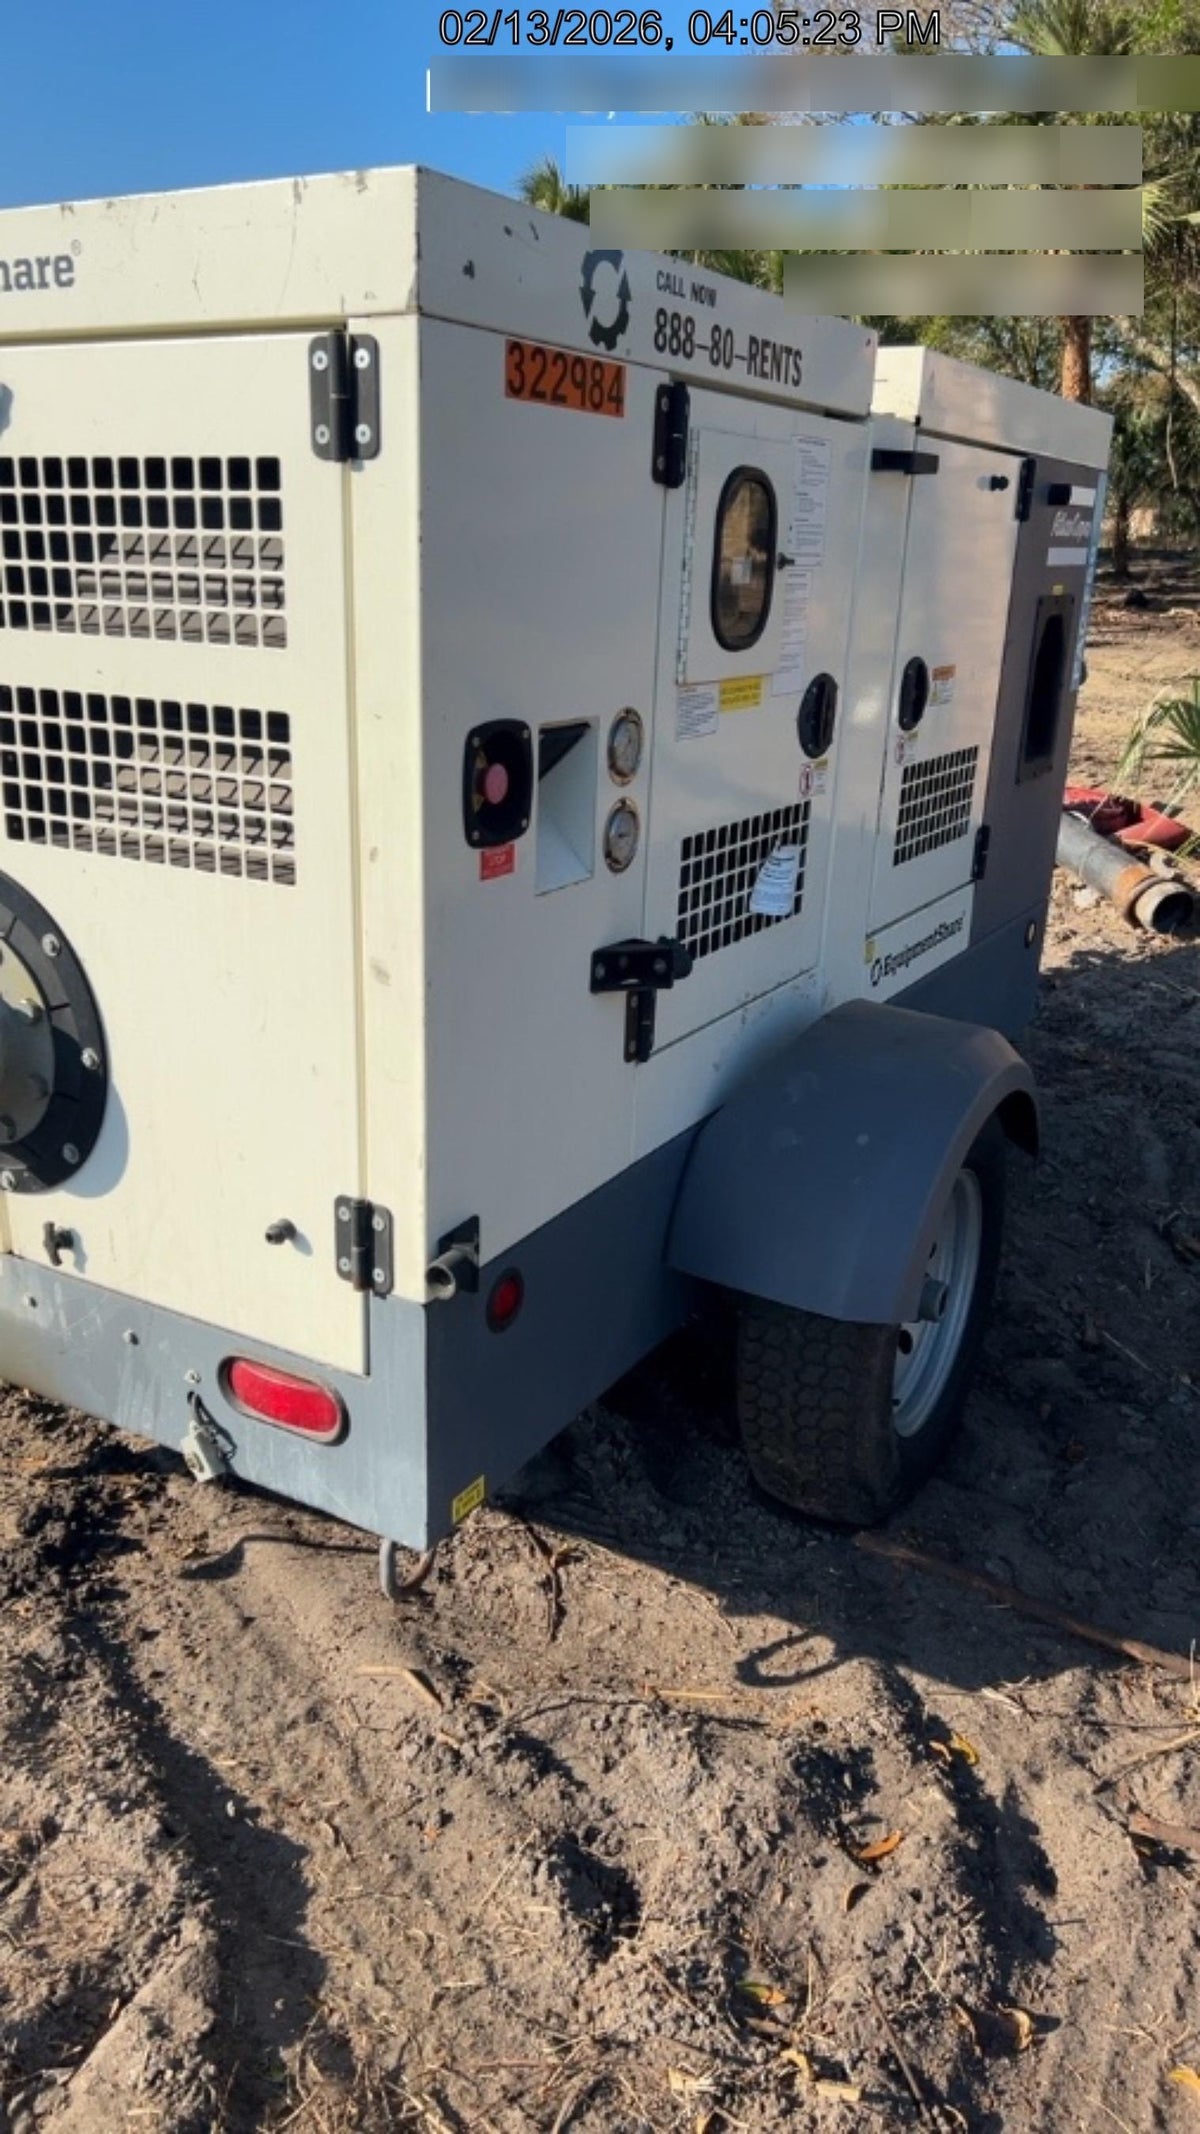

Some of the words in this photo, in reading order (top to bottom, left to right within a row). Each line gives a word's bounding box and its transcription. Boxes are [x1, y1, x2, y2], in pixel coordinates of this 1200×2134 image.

[656, 269, 686, 299] CALL
[507, 340, 625, 415] 322984
[653, 306, 803, 388] 888-80-RENTS
